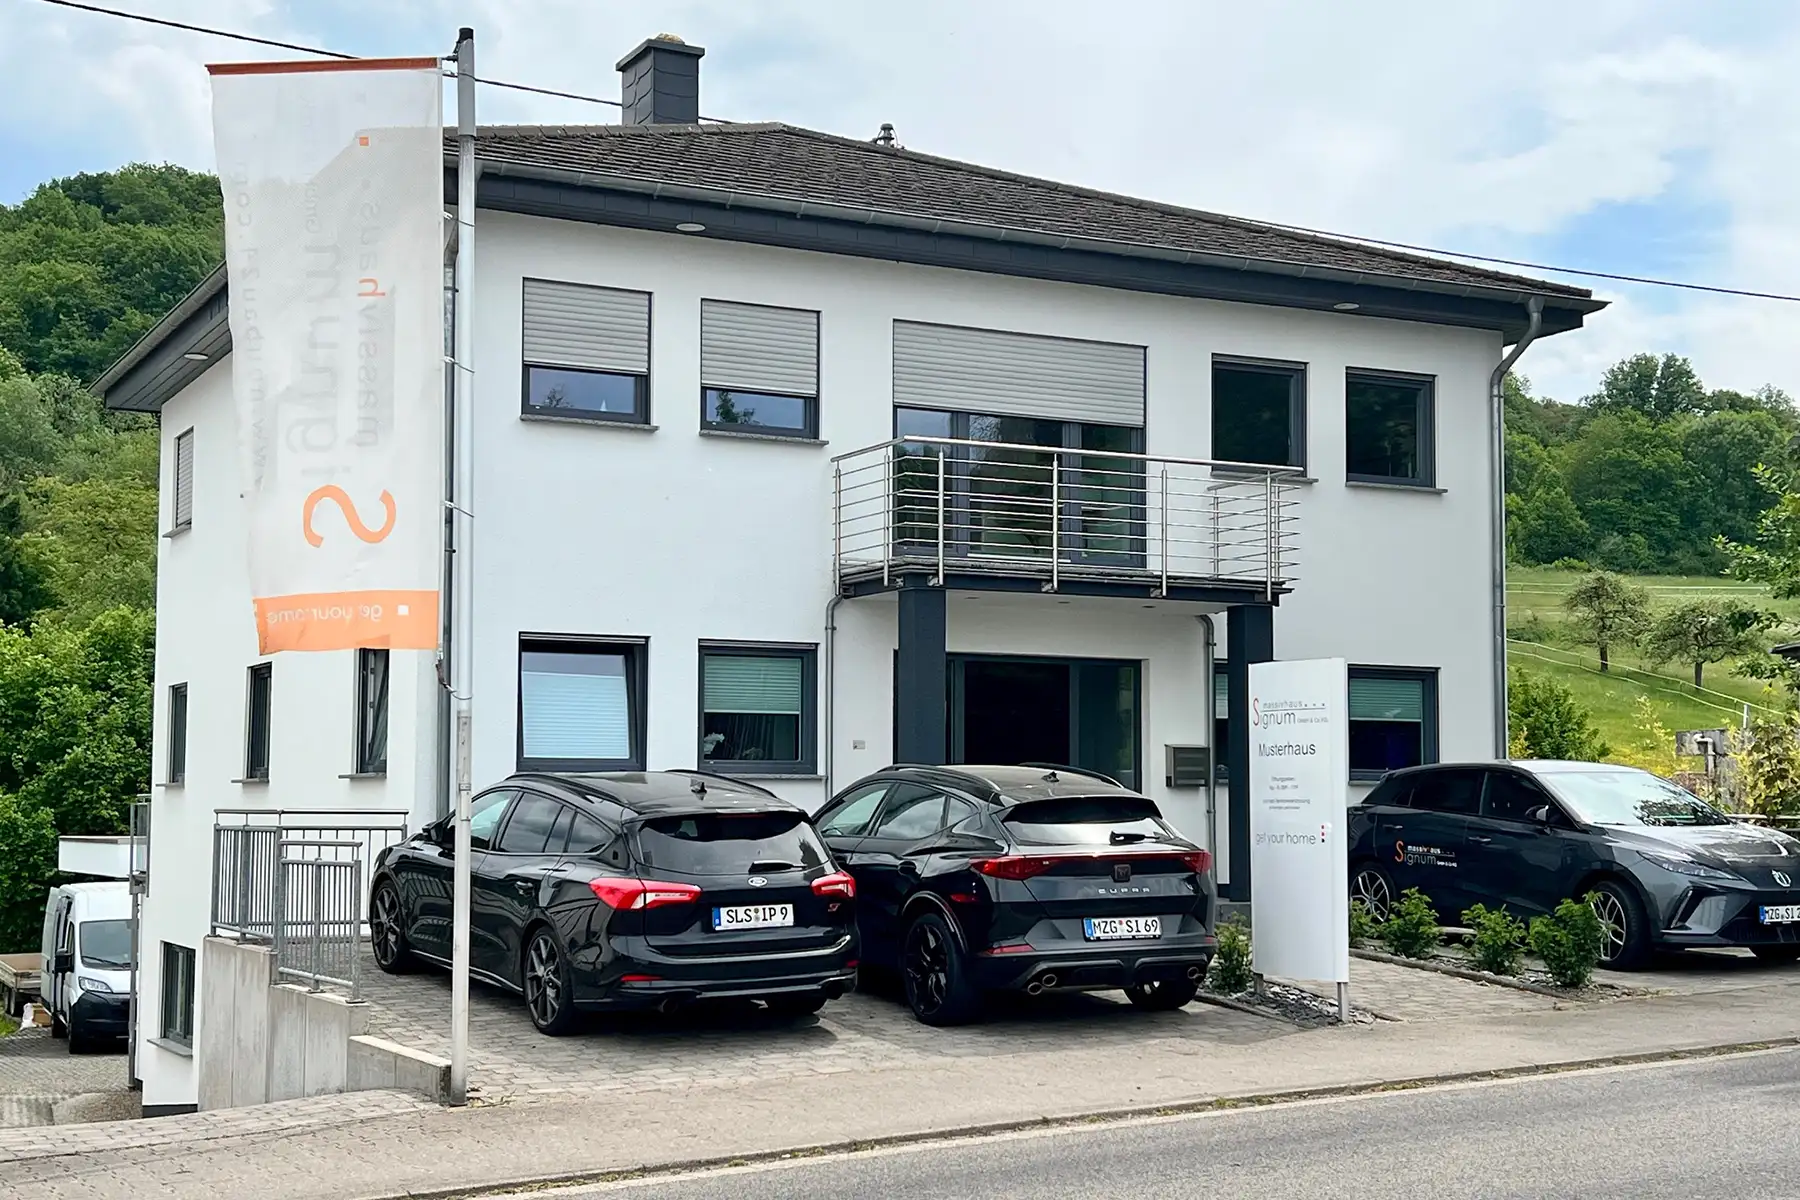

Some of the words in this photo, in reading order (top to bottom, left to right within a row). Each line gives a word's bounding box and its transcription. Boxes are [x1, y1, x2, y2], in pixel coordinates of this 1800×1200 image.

[1253, 697, 1296, 730] Signum
[1259, 742, 1317, 757] Musterhaus
[1267, 834, 1284, 845] your
[1286, 832, 1316, 845] home
[1395, 840, 1437, 866] Signum
[726, 907, 752, 924] SLS
[762, 907, 777, 922] IP
[780, 906, 788, 920] 9
[1093, 920, 1118, 934] MZG
[1144, 919, 1158, 932] 69
